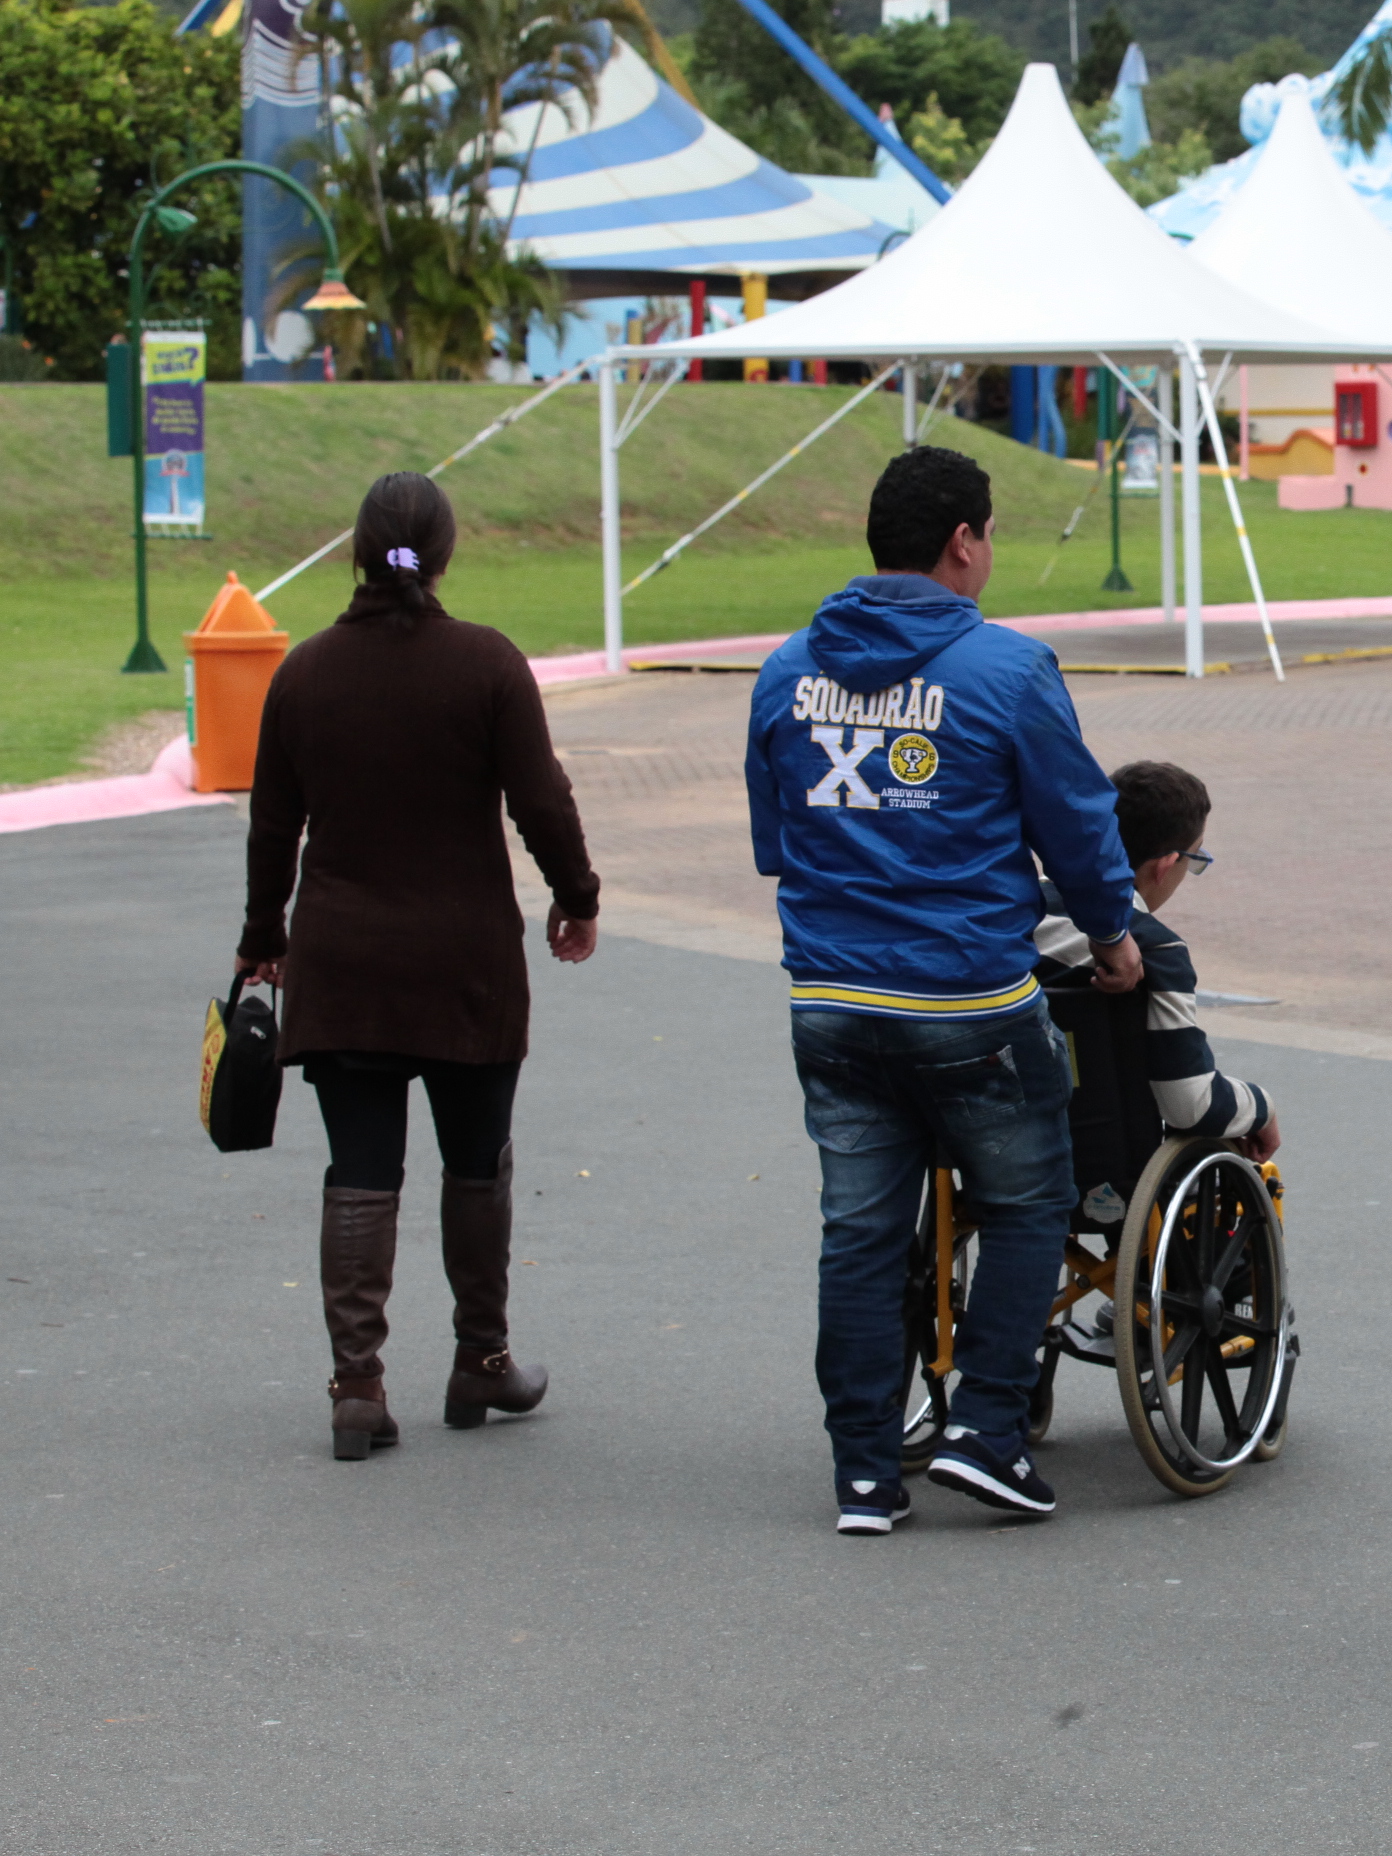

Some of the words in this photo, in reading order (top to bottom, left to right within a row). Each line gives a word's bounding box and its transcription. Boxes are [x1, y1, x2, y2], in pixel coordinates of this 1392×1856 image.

[806, 723, 885, 810] X
[880, 788, 939, 800] ARROWHEAD
[888, 798, 932, 810] STADIUM
